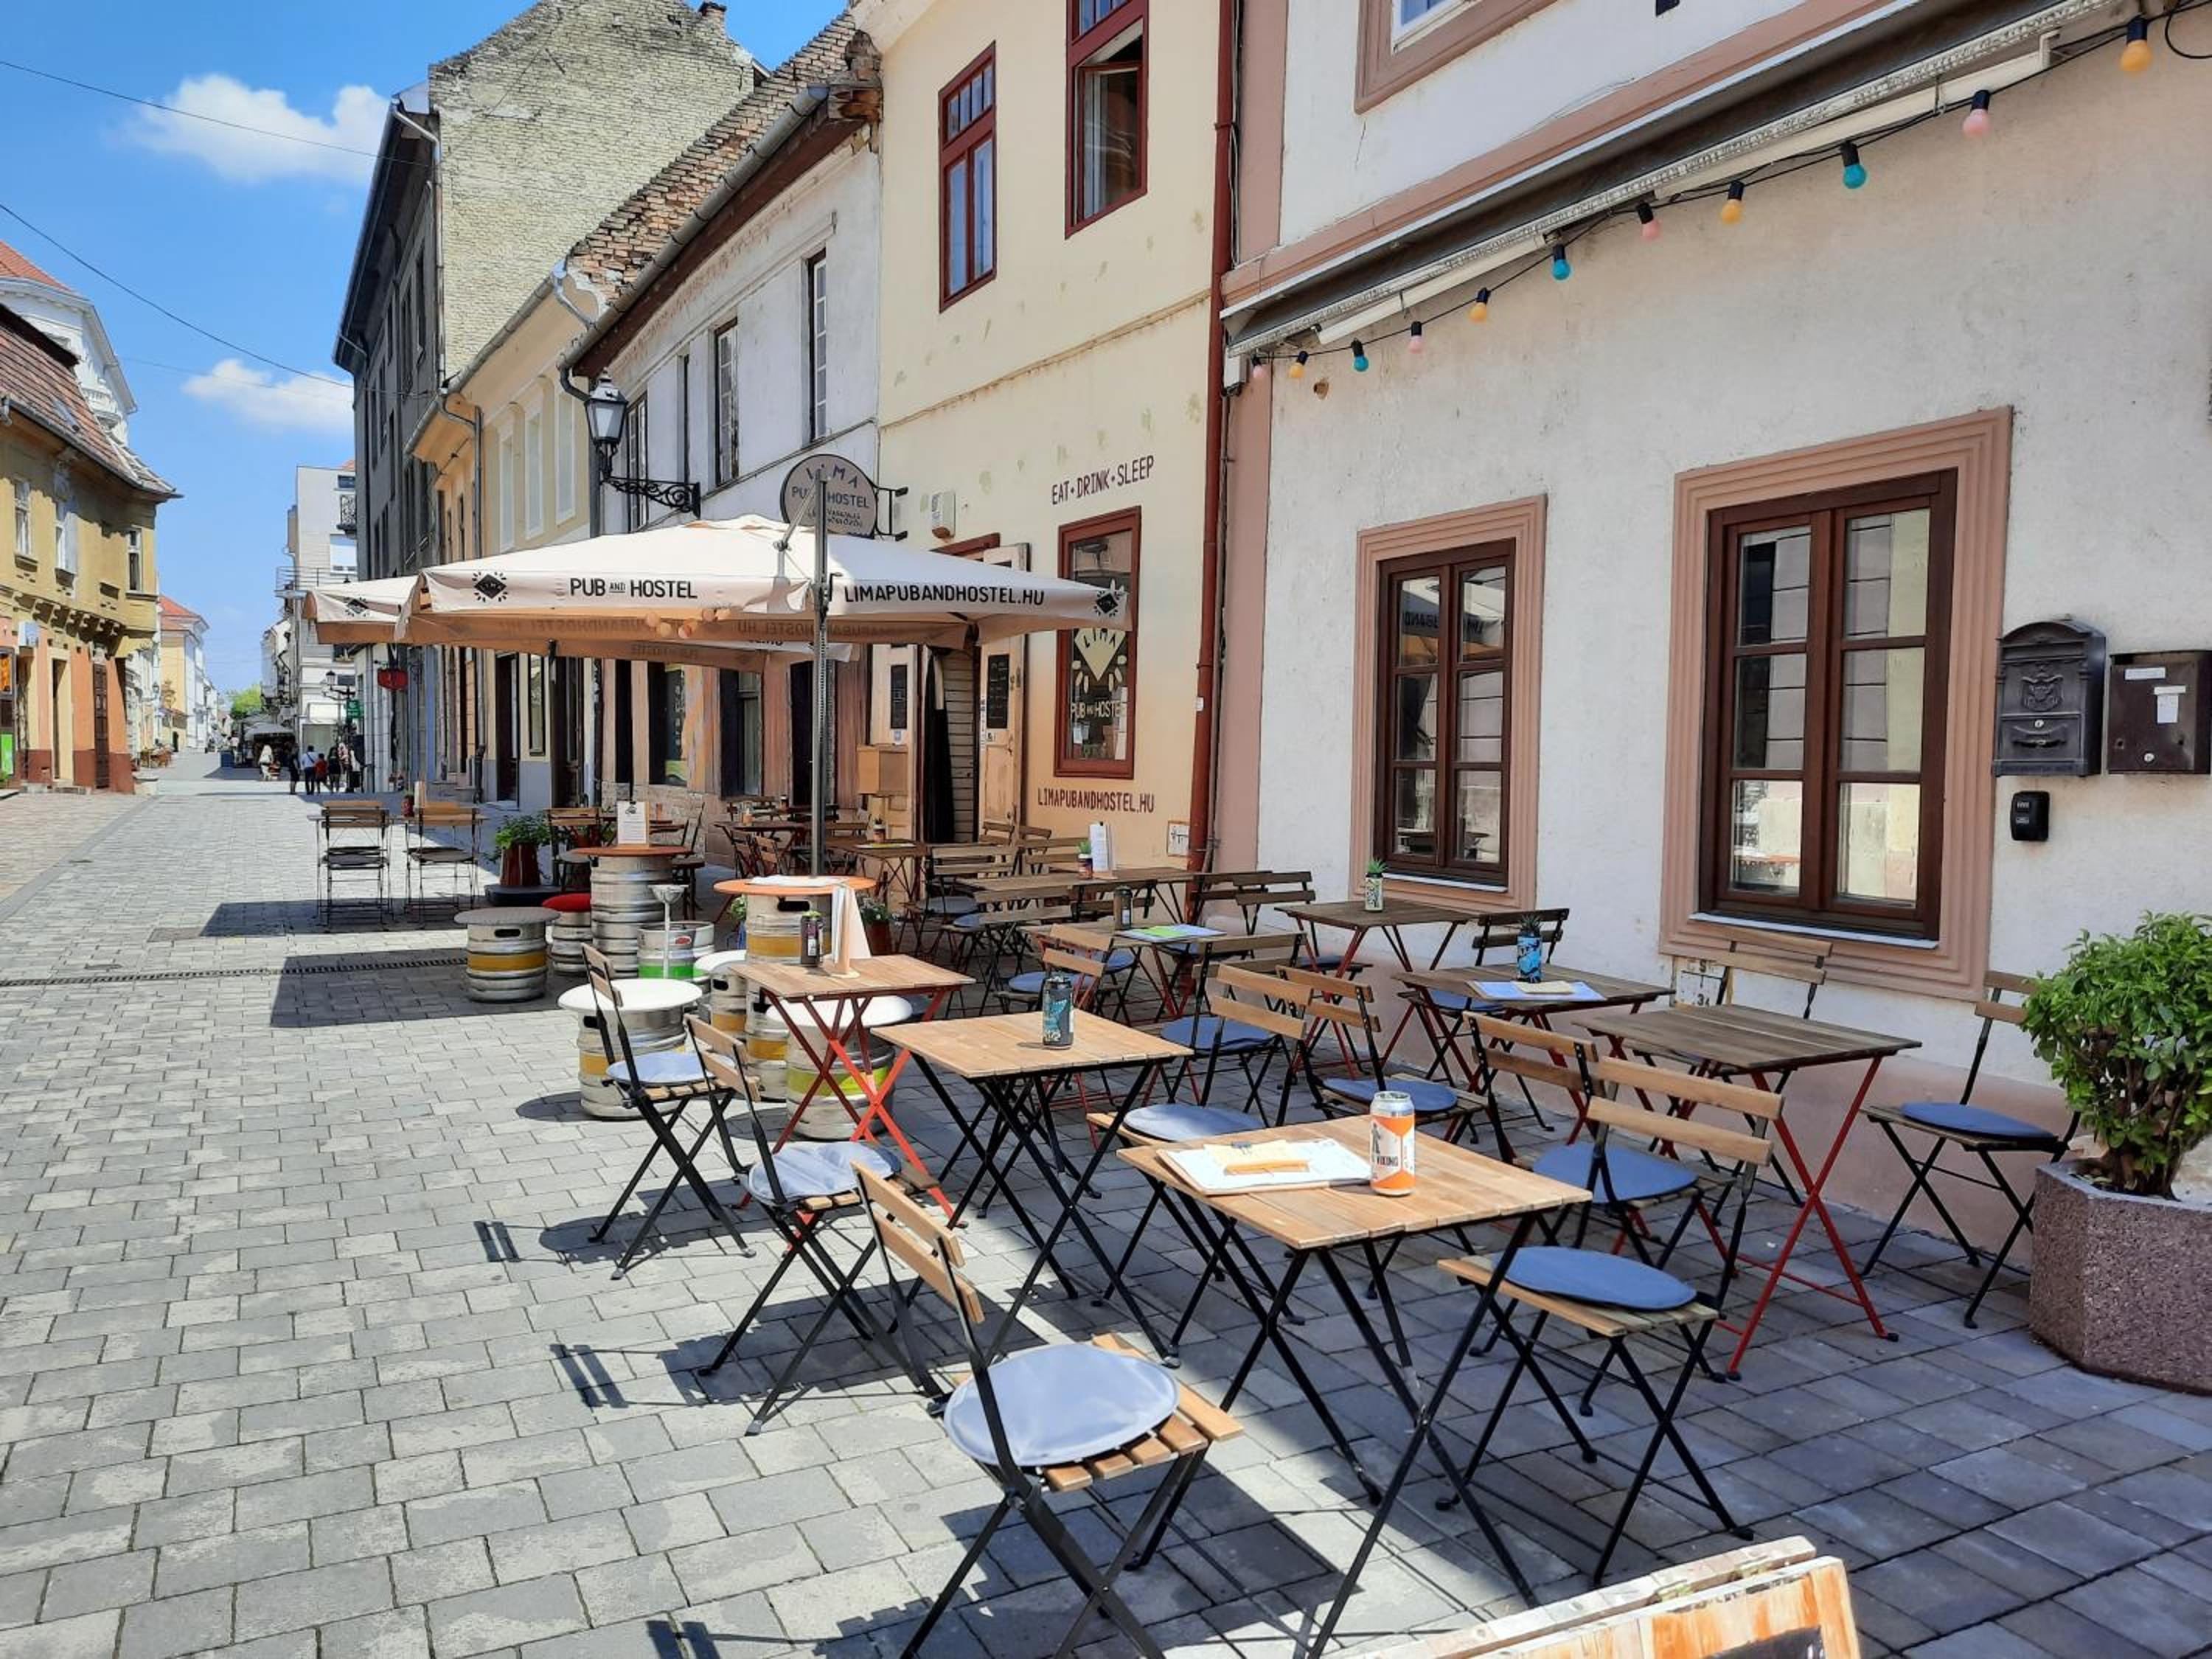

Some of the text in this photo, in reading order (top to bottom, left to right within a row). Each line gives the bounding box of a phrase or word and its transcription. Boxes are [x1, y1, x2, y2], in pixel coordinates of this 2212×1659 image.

[806, 464, 858, 490] LMA
[1117, 455, 1155, 487] SLEEP
[827, 492, 870, 508] HOSTEL
[570, 578, 698, 599] PUB AND HOSTEL
[844, 585, 1045, 606] LIMAPUBANDHOSTEL.HU
[1071, 703, 1086, 719] PUB
[1037, 788, 1155, 813] LIMAPUBANDHOSTEL.HU
